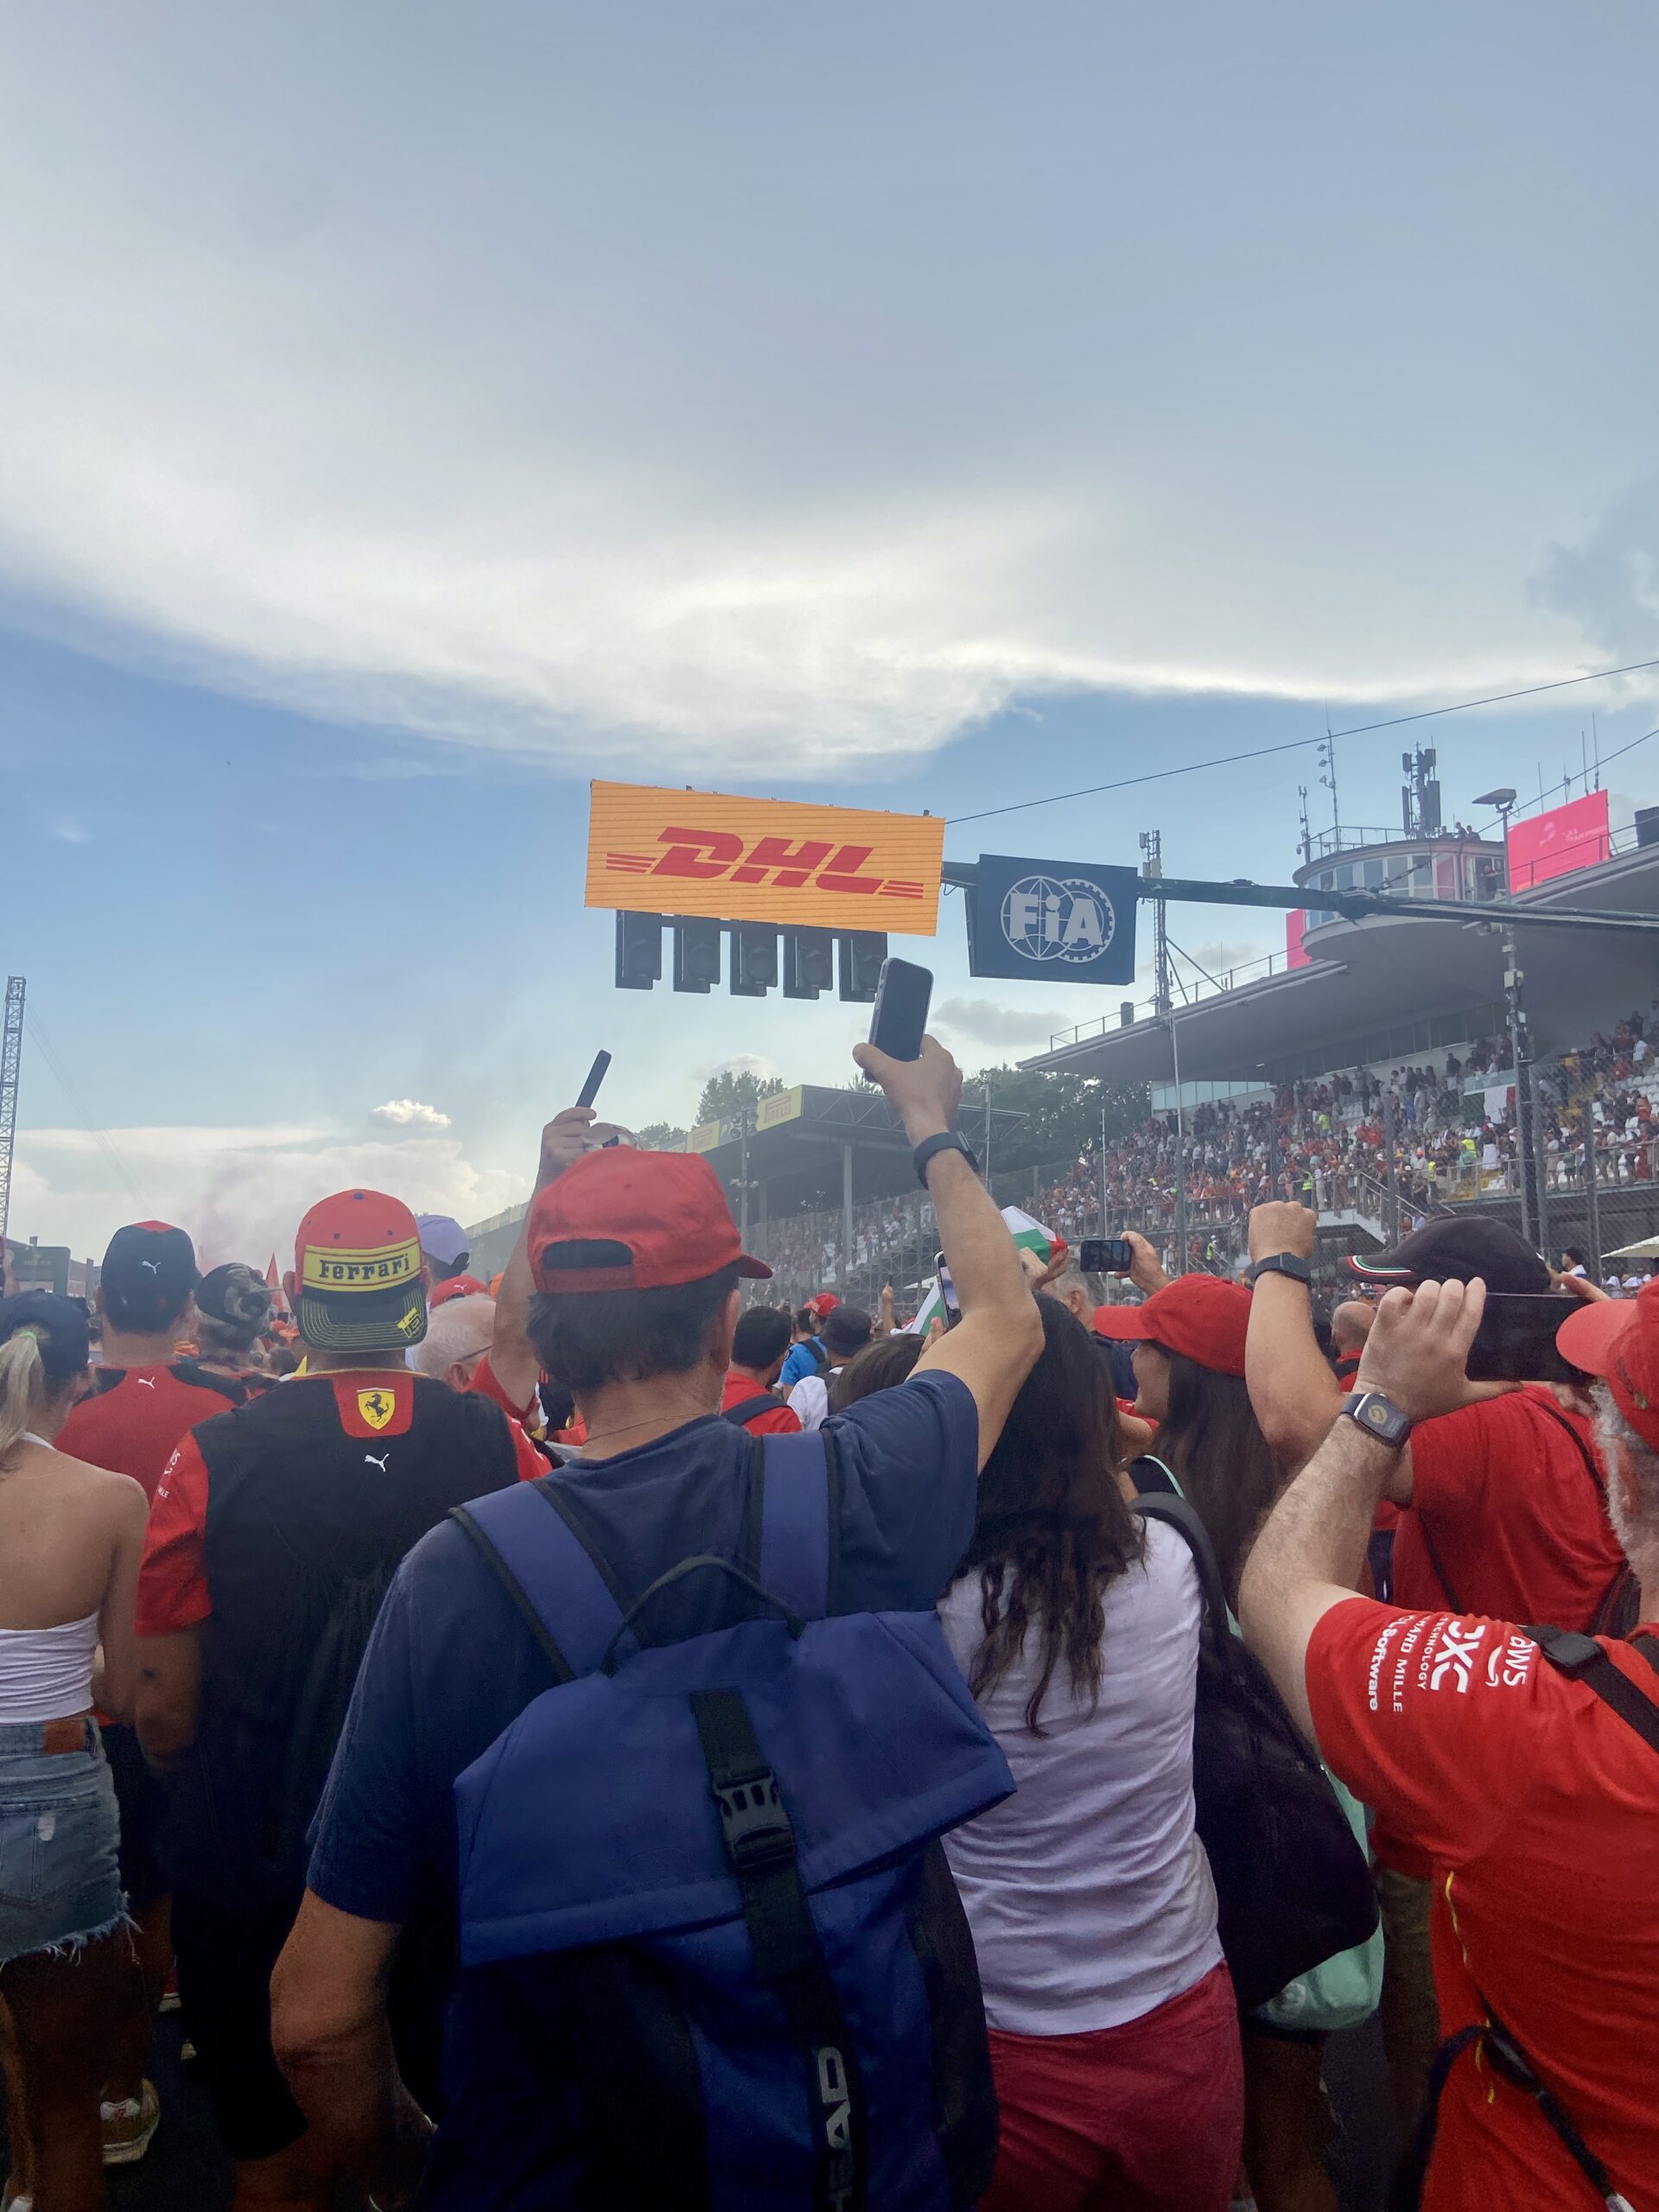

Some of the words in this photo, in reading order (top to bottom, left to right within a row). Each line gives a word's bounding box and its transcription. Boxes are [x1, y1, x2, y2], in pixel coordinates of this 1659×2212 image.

[650, 826, 885, 895] DHL
[318, 1253, 410, 1280] Ferrari
[1393, 1659, 1408, 1712] MILLE
[1429, 1620, 1485, 1694] DXC
